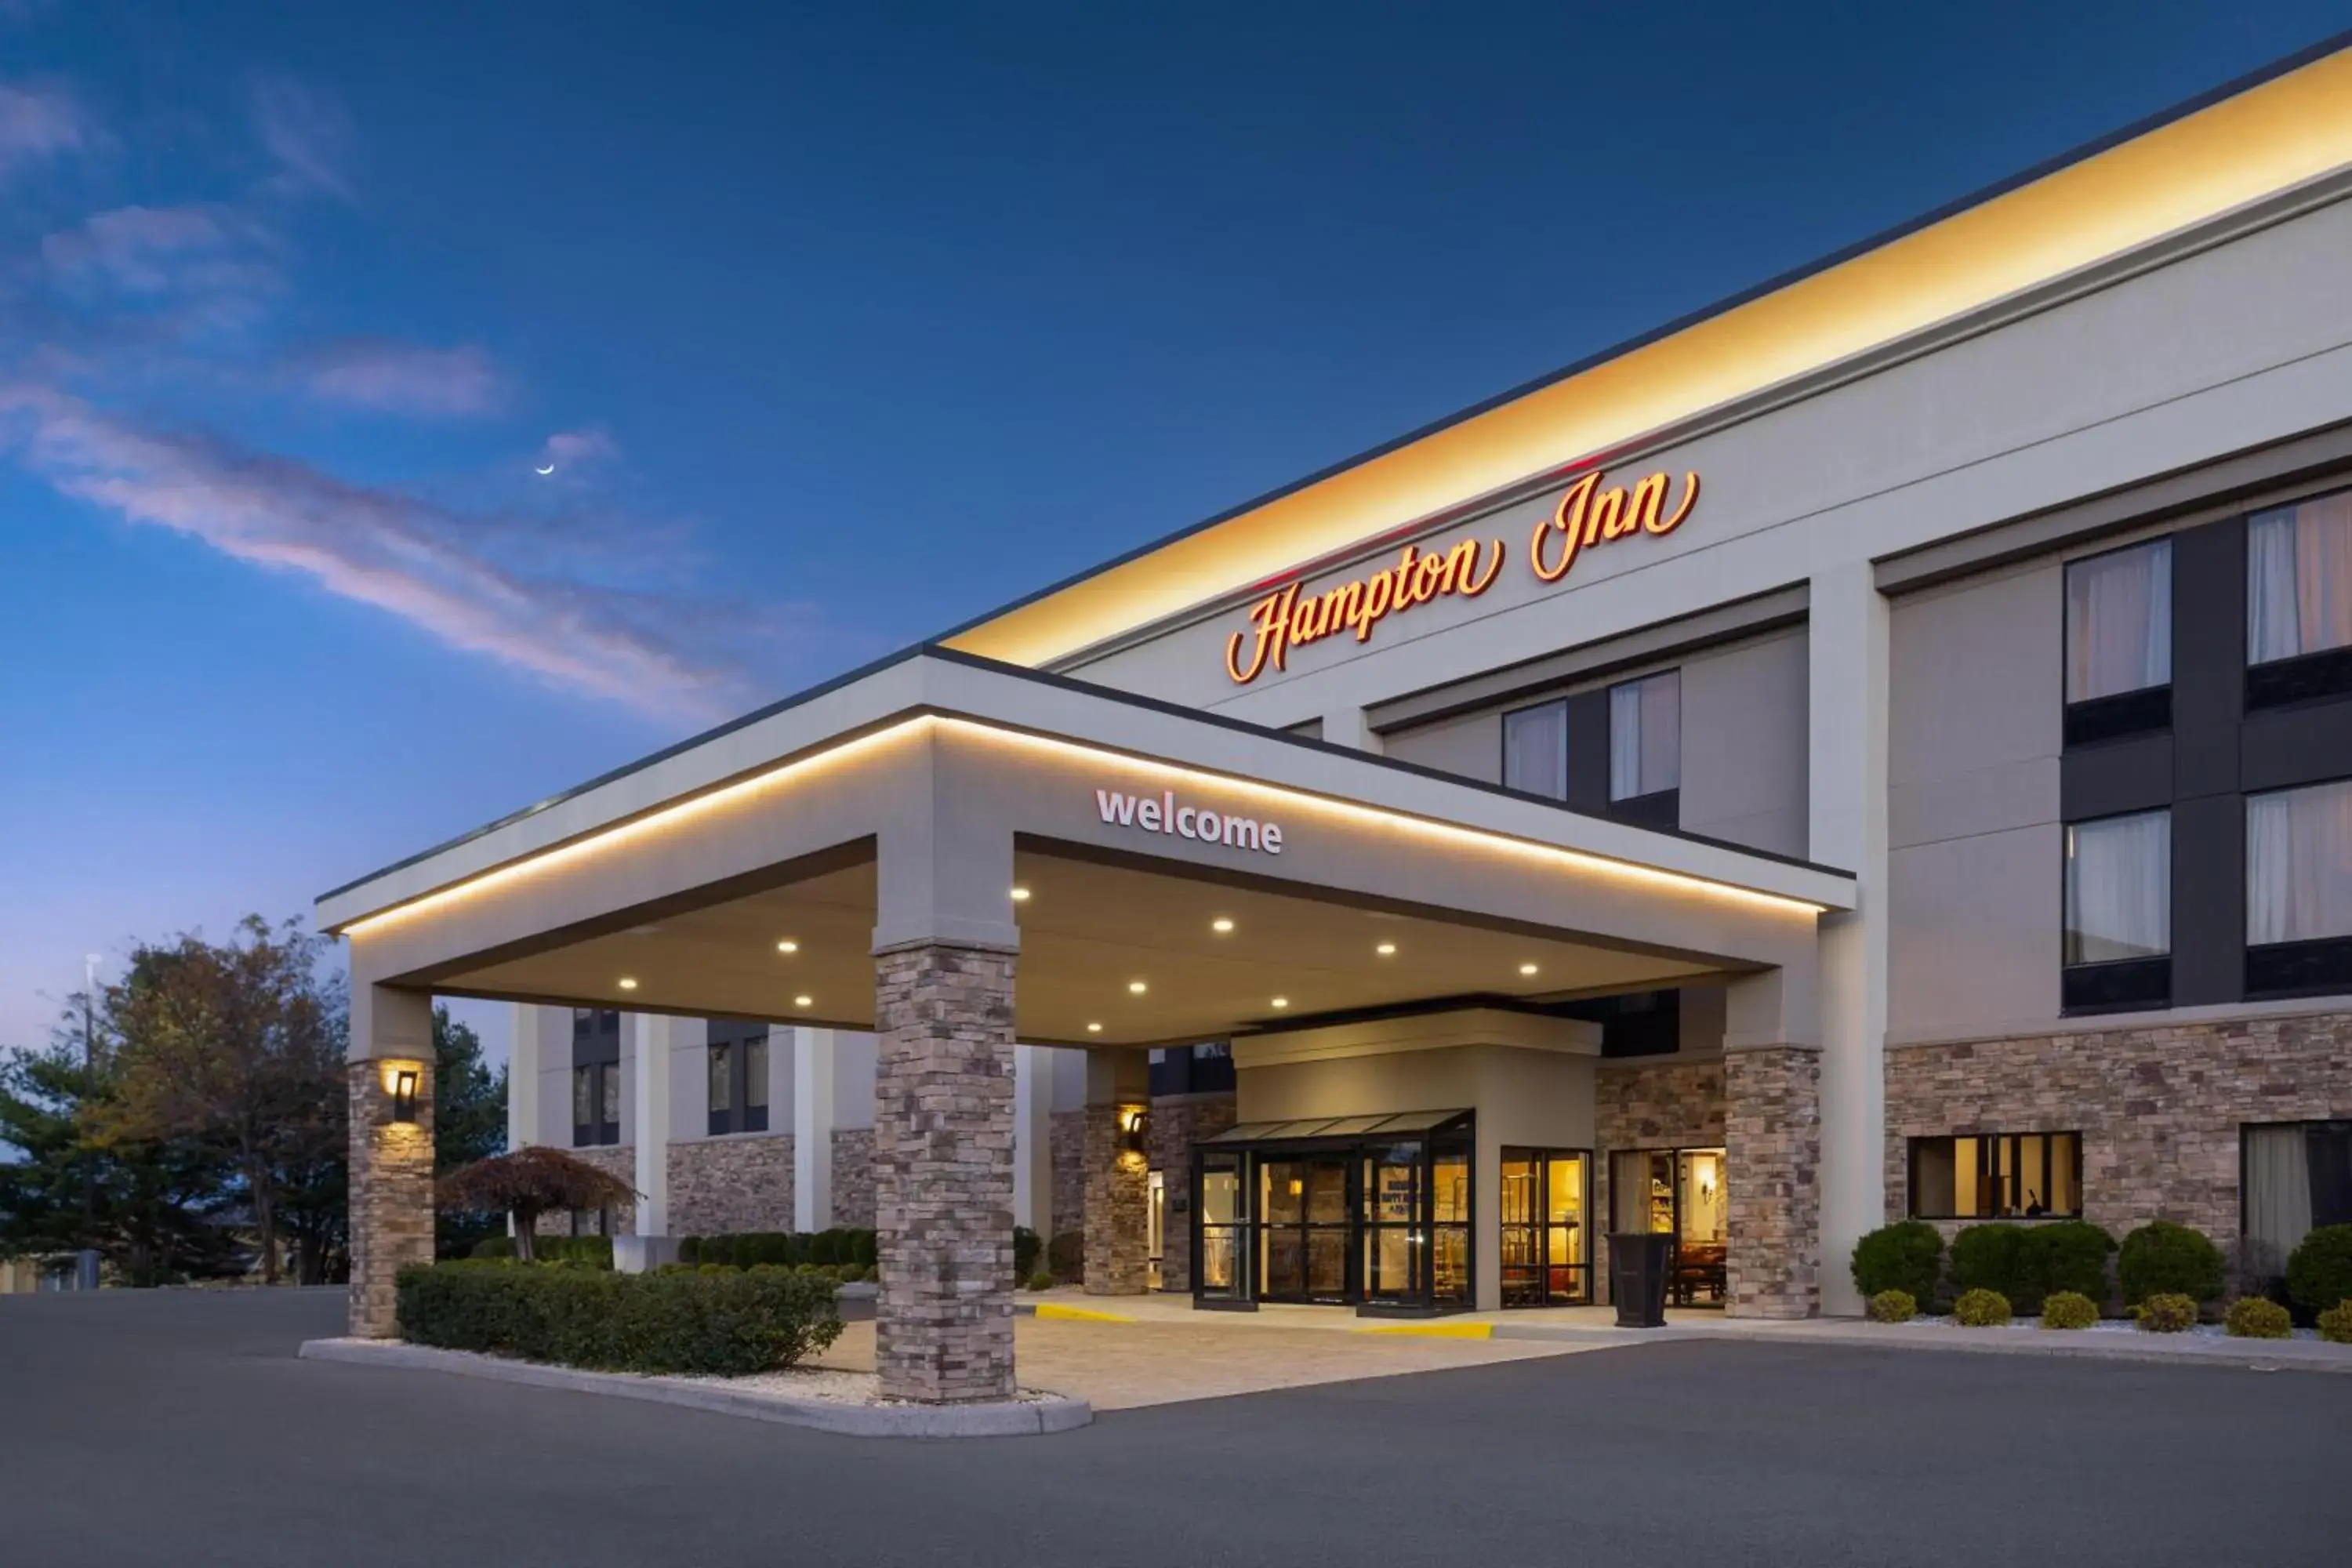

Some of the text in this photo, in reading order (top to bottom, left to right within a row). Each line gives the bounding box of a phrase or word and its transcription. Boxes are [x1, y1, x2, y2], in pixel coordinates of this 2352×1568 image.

[1227, 470, 1700, 684] Hampton Inn
[1095, 789, 1283, 855] welcome
